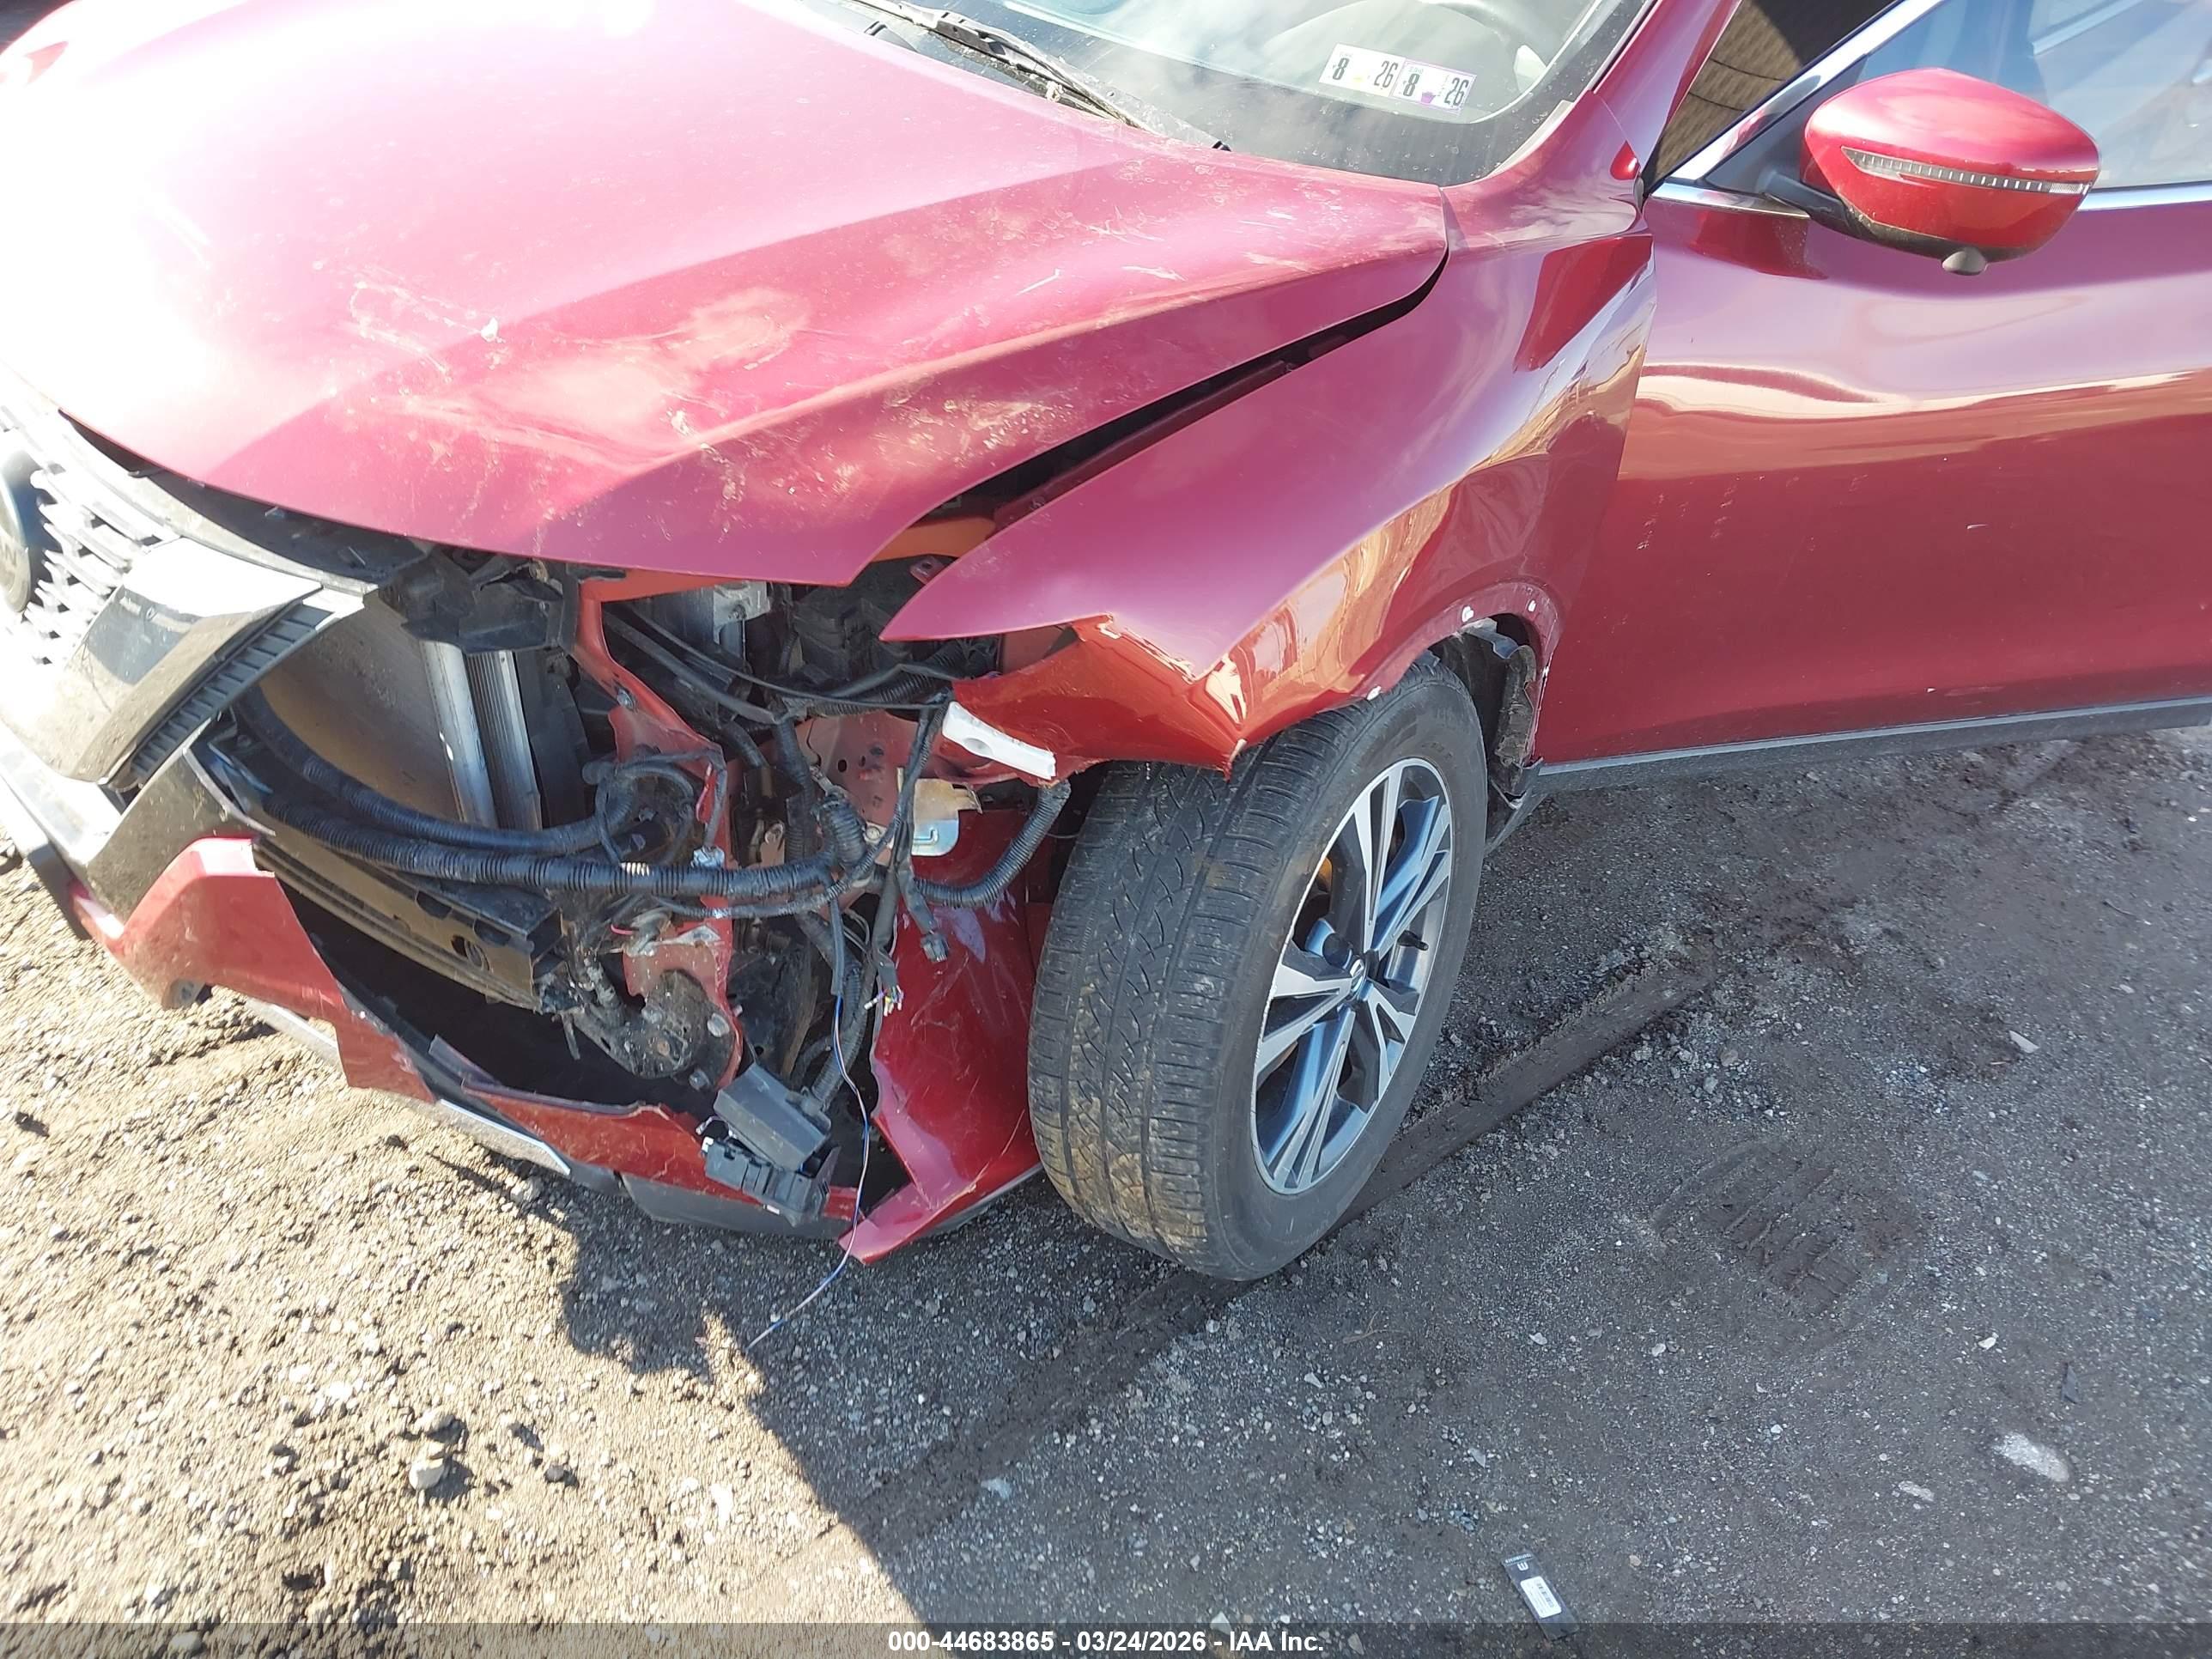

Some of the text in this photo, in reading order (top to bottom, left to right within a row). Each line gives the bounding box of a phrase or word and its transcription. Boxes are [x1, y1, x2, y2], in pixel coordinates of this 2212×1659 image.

[1332, 57, 1399, 88] 8 26
[1402, 73, 1469, 106] 8 26
